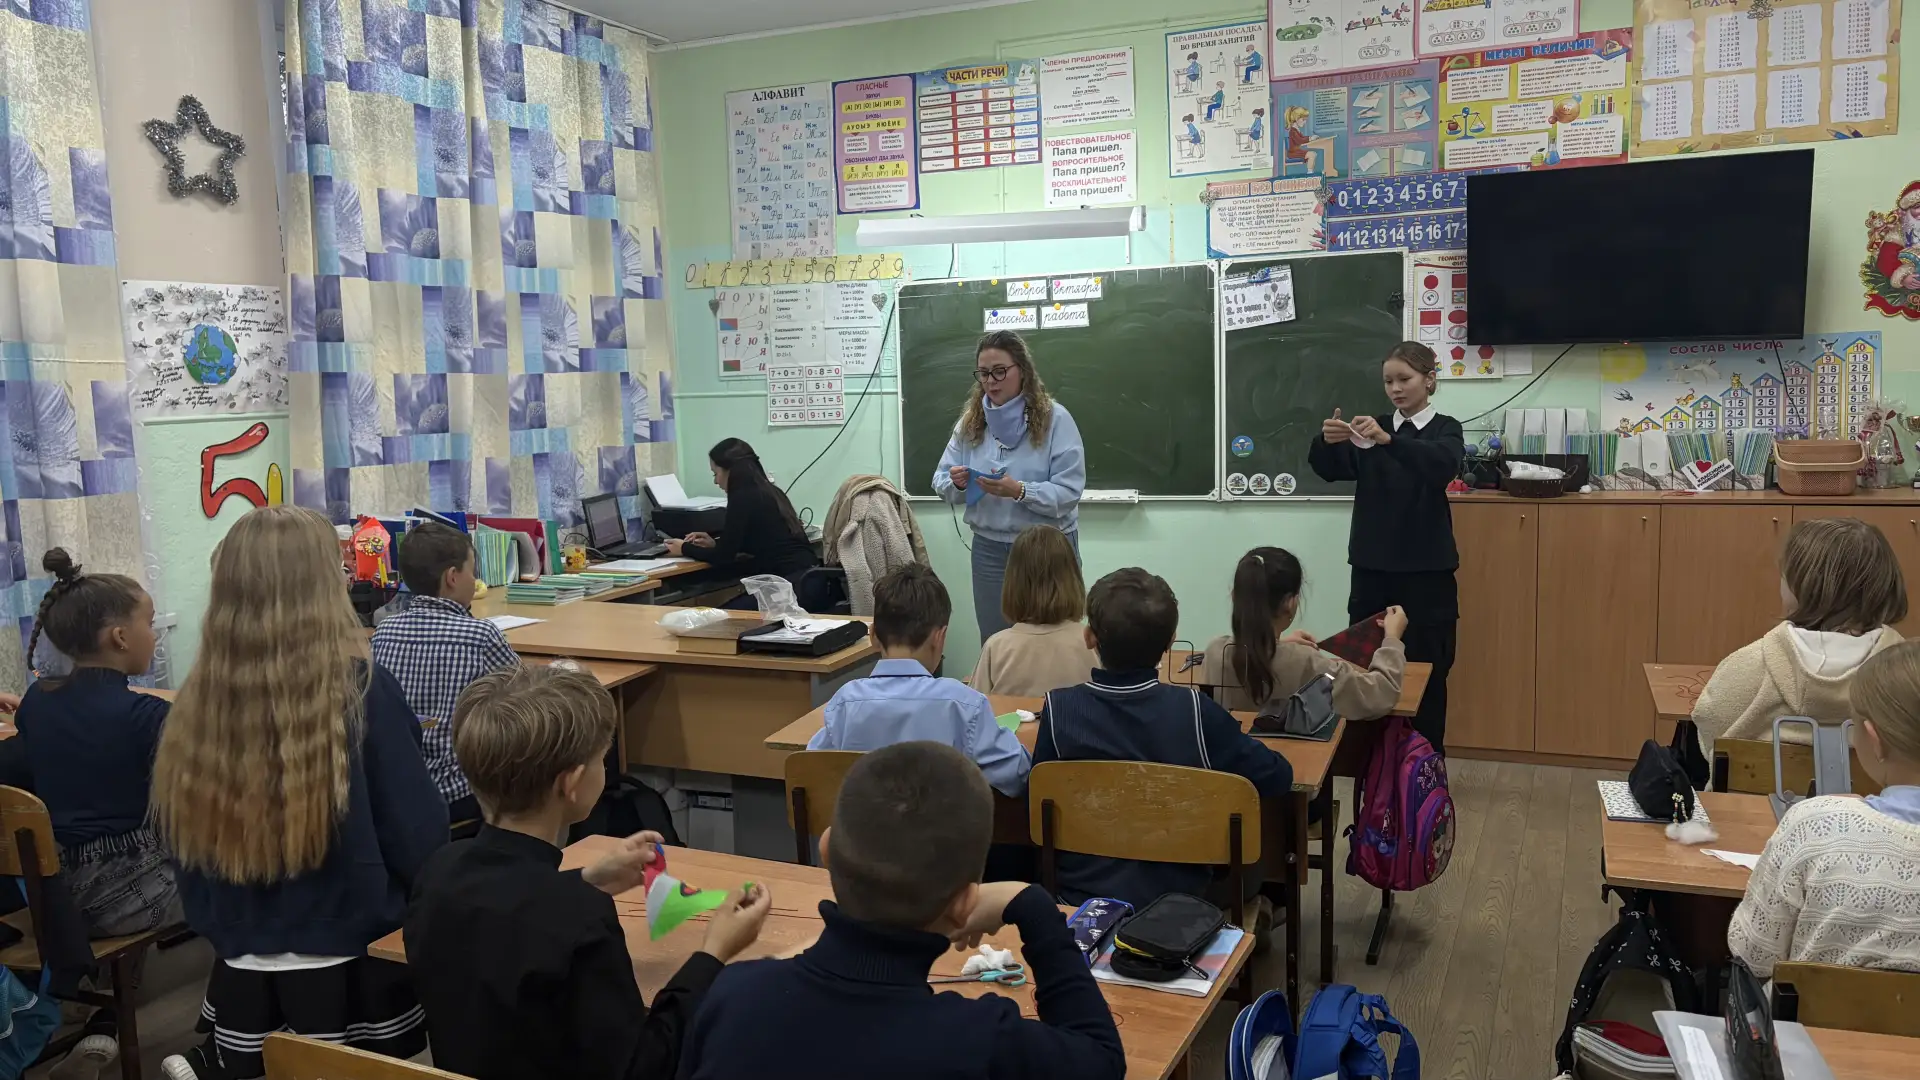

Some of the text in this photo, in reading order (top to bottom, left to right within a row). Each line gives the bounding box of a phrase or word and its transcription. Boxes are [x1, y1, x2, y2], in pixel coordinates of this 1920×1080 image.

[1172, 25, 1262, 42] ПРАВИЛЬНАЯ ПОСАДКА
[1192, 40, 1216, 50] ВРЕМЯ
[1218, 34, 1255, 45] ЗАНЯТИЙ
[1485, 38, 1595, 60] МЕРЫ ВЕЛИЧИН
[1072, 52, 1126, 63] ПРЕДЛОЖЕНИЯ
[950, 67, 1005, 81] ЧАСТИ РЕЧИ
[856, 81, 888, 91] ГЛАСНЫЕ
[752, 86, 805, 101] АЛФАВИТ
[1045, 133, 1131, 147] ПОВЕСТВОВАТЕЛЬНОЕ
[1052, 144, 1122, 156] Папа пришел.
[1052, 154, 1124, 167] ВОПРОСИТЕЛЬНОЕ
[1053, 162, 1126, 176] Папа пришел?
[1052, 176, 1127, 187] ВОСКЛИЦАТЕЛЬНОЕ
[1053, 184, 1123, 197] Папа пришел!
[1338, 181, 1458, 207] 0 1 2 3 4 5 6 7
[1338, 223, 1460, 246] 11 12 13 14 15 16 17
[686, 258, 903, 286] 0 2 3 4 5 6 7 8 9
[1008, 277, 1100, 300] Второе октября
[986, 305, 1086, 328] Классная работа
[1670, 341, 1783, 354] СОСТАВ ЧИСЛА
